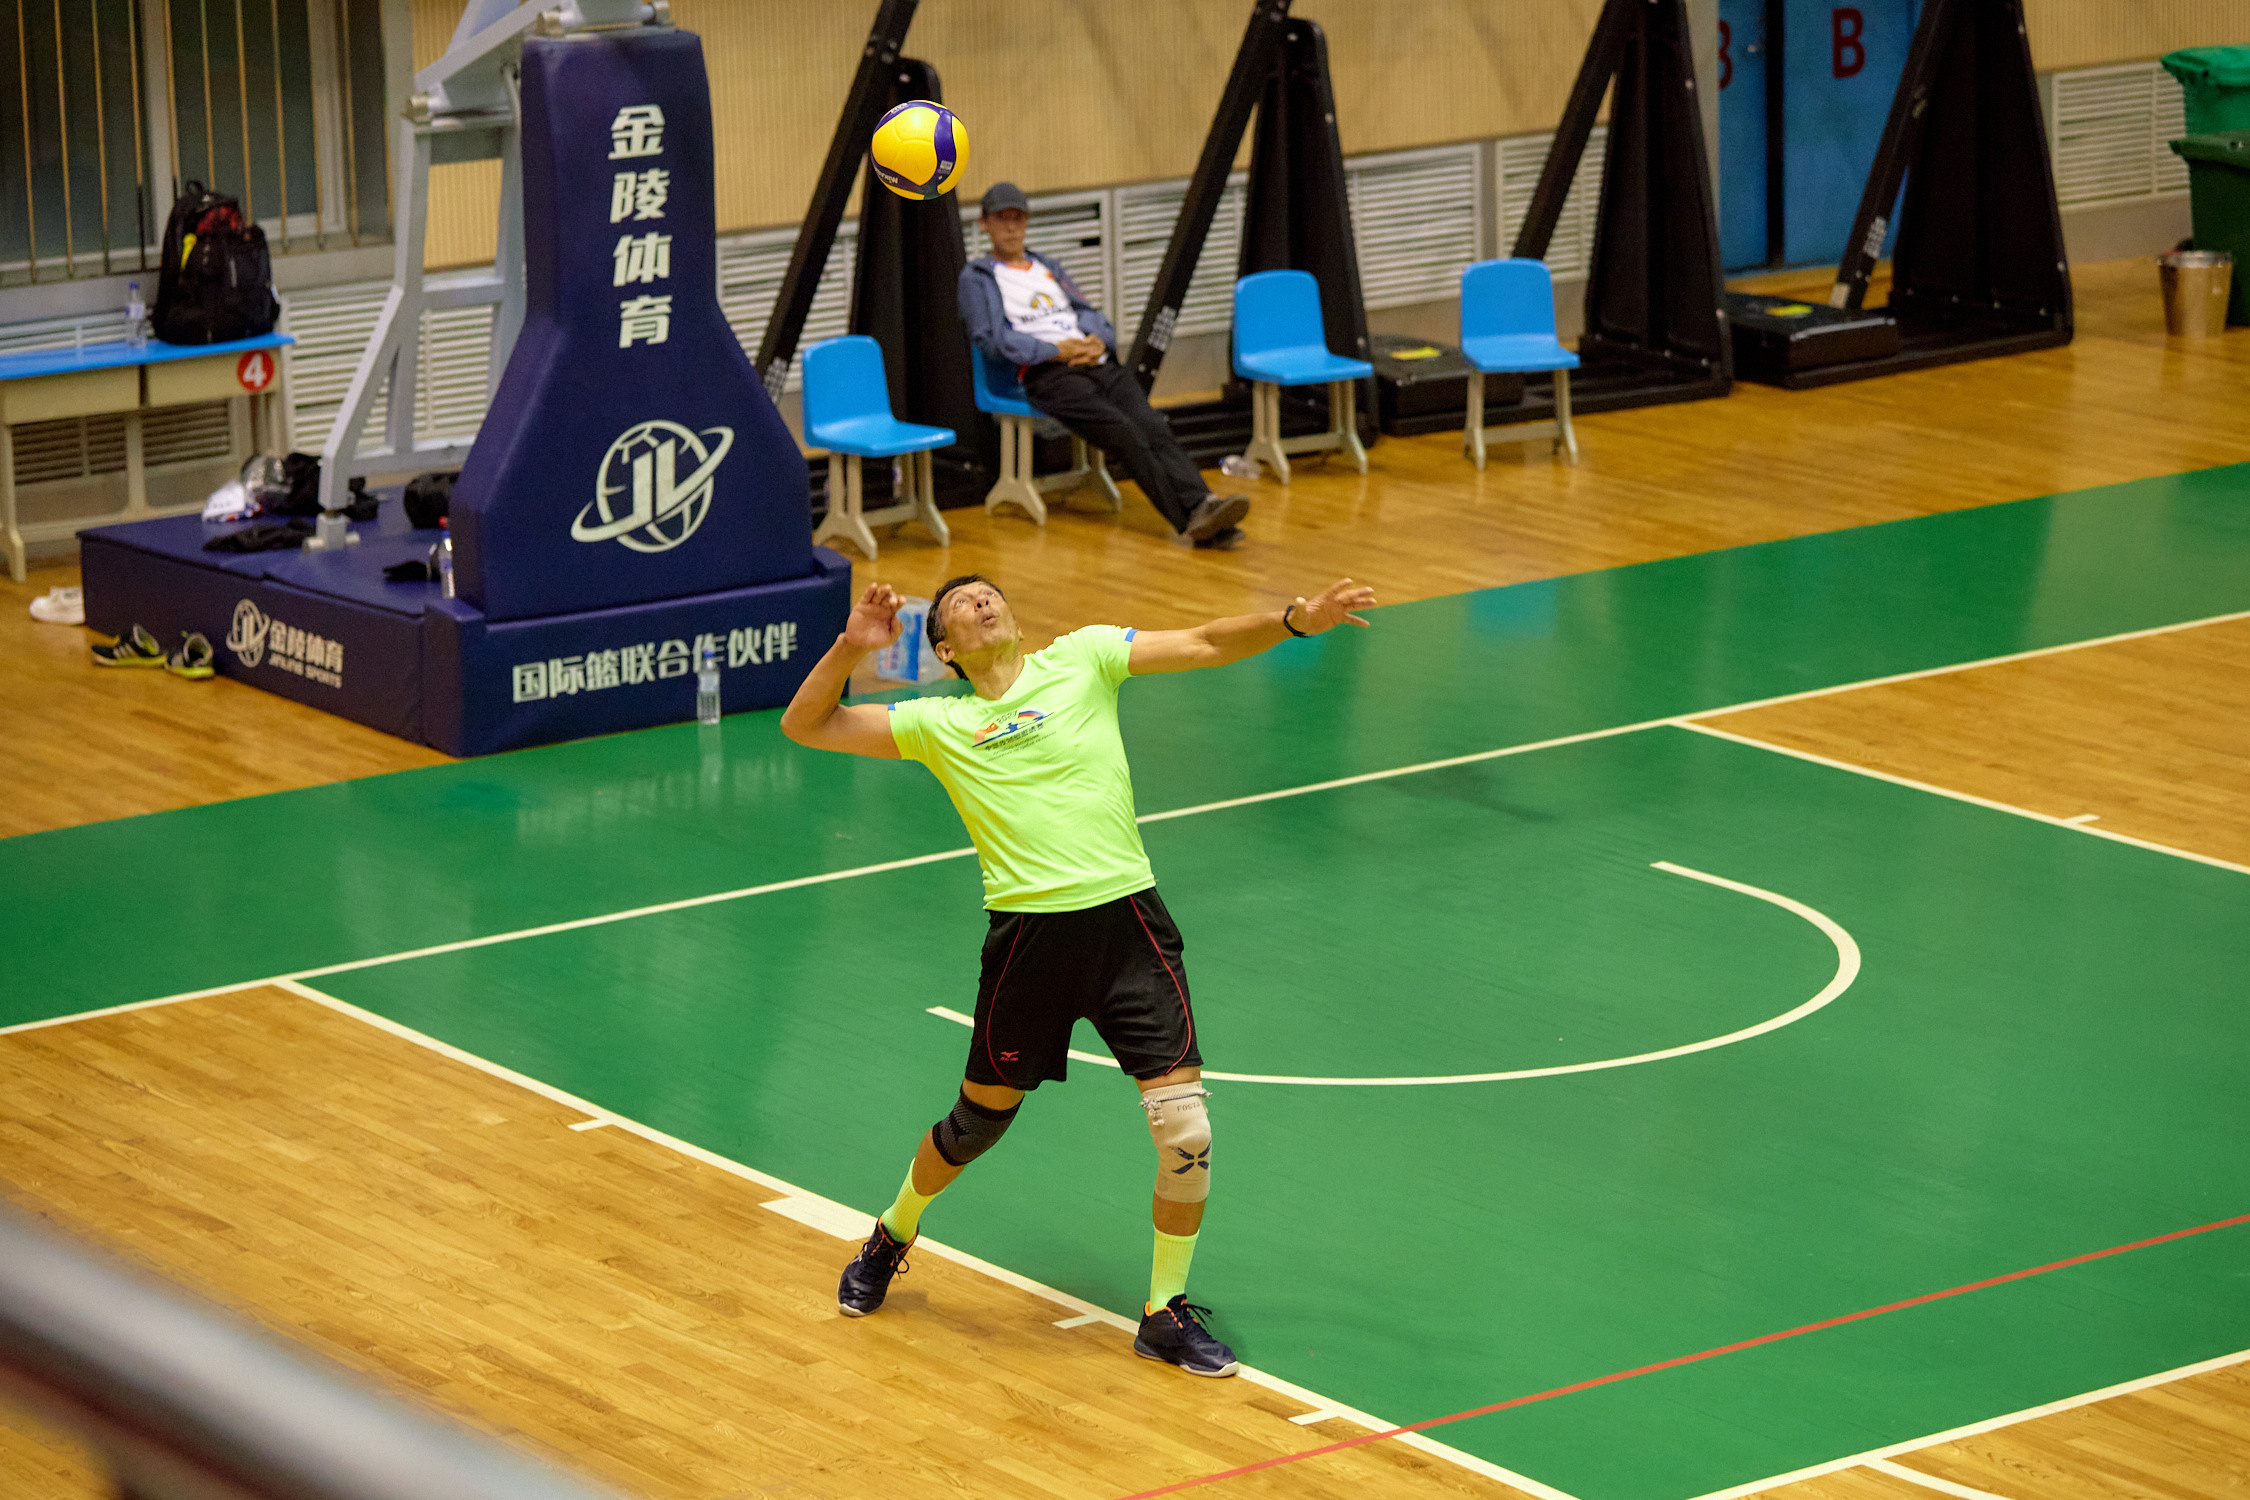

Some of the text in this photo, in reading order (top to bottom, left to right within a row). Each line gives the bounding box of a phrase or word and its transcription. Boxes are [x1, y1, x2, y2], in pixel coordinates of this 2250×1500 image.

[1832, 7, 1866, 79] B
[608, 103, 673, 349] 金陵体育
[243, 353, 268, 388] 4
[268, 619, 344, 674] 金陵体育
[512, 622, 798, 704] 国际篮联合作伙伴
